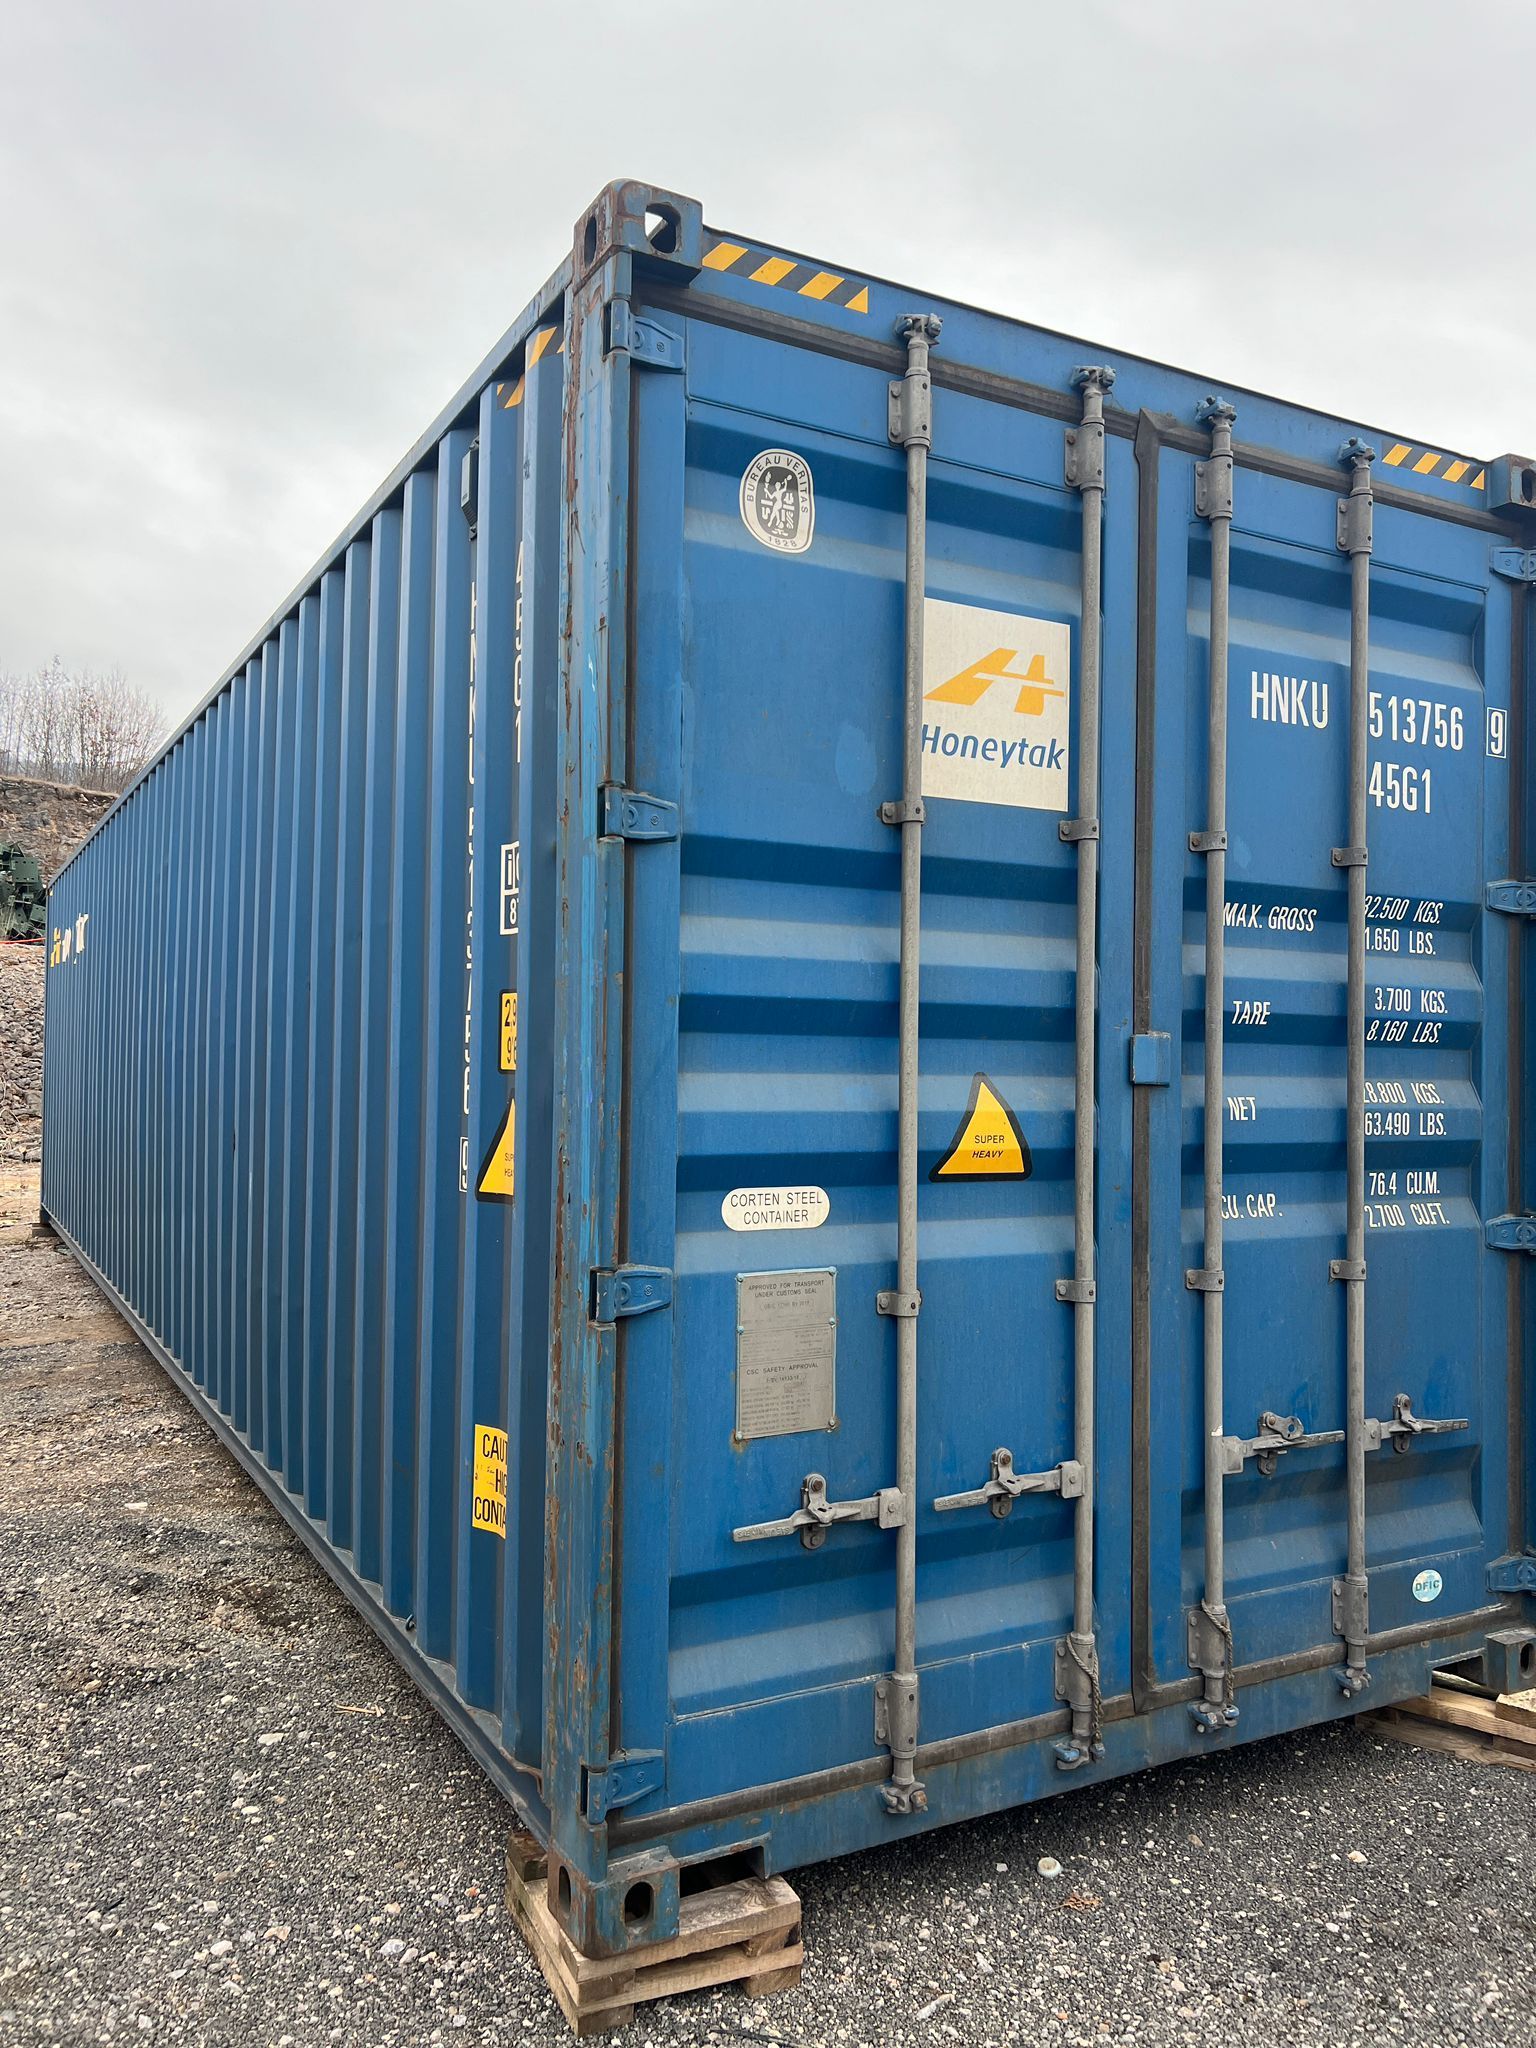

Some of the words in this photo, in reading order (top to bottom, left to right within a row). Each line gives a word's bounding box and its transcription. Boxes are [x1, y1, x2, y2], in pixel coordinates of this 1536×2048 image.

[746, 456, 781, 502] BUREAU
[787, 457, 809, 513] VERITAS
[768, 536, 798, 548] 1828
[1251, 671, 1329, 729] HNKU
[1369, 692, 1463, 751] 513756
[1490, 711, 1504, 755] 9
[921, 723, 1065, 770] Honeytak
[1368, 761, 1431, 814] 45G1
[1222, 902, 1263, 929] MAX.
[1268, 905, 1318, 932] GROSS
[1413, 900, 1444, 925] KGS.
[1409, 930, 1437, 956] LBS.
[1231, 1000, 1271, 1025] TARE
[1421, 989, 1448, 1014] KGS.
[1411, 1021, 1442, 1044] LBS.
[1227, 1096, 1256, 1121] NET
[1410, 1082, 1445, 1105] KGS.
[1364, 1112, 1410, 1136] 63,490
[1419, 1112, 1447, 1136] LBS.
[974, 1134, 1005, 1144] SUPER
[971, 1150, 1004, 1159] HEAVY
[730, 1193, 780, 1208] CORTEN
[786, 1191, 823, 1205] STEEL
[1221, 1194, 1245, 1220] CU.
[1246, 1193, 1283, 1218] CAP.
[1368, 1172, 1397, 1196] 76.4
[1406, 1171, 1441, 1195] CU.M.
[743, 1209, 809, 1225] CONTAINER
[776, 1289, 802, 1297] CUSTOMS
[794, 1279, 825, 1287] TRANSPORT
[762, 1366, 785, 1374] SAFETY
[788, 1362, 819, 1371] APPROVAL
[1415, 1579, 1440, 1592] DFIC
